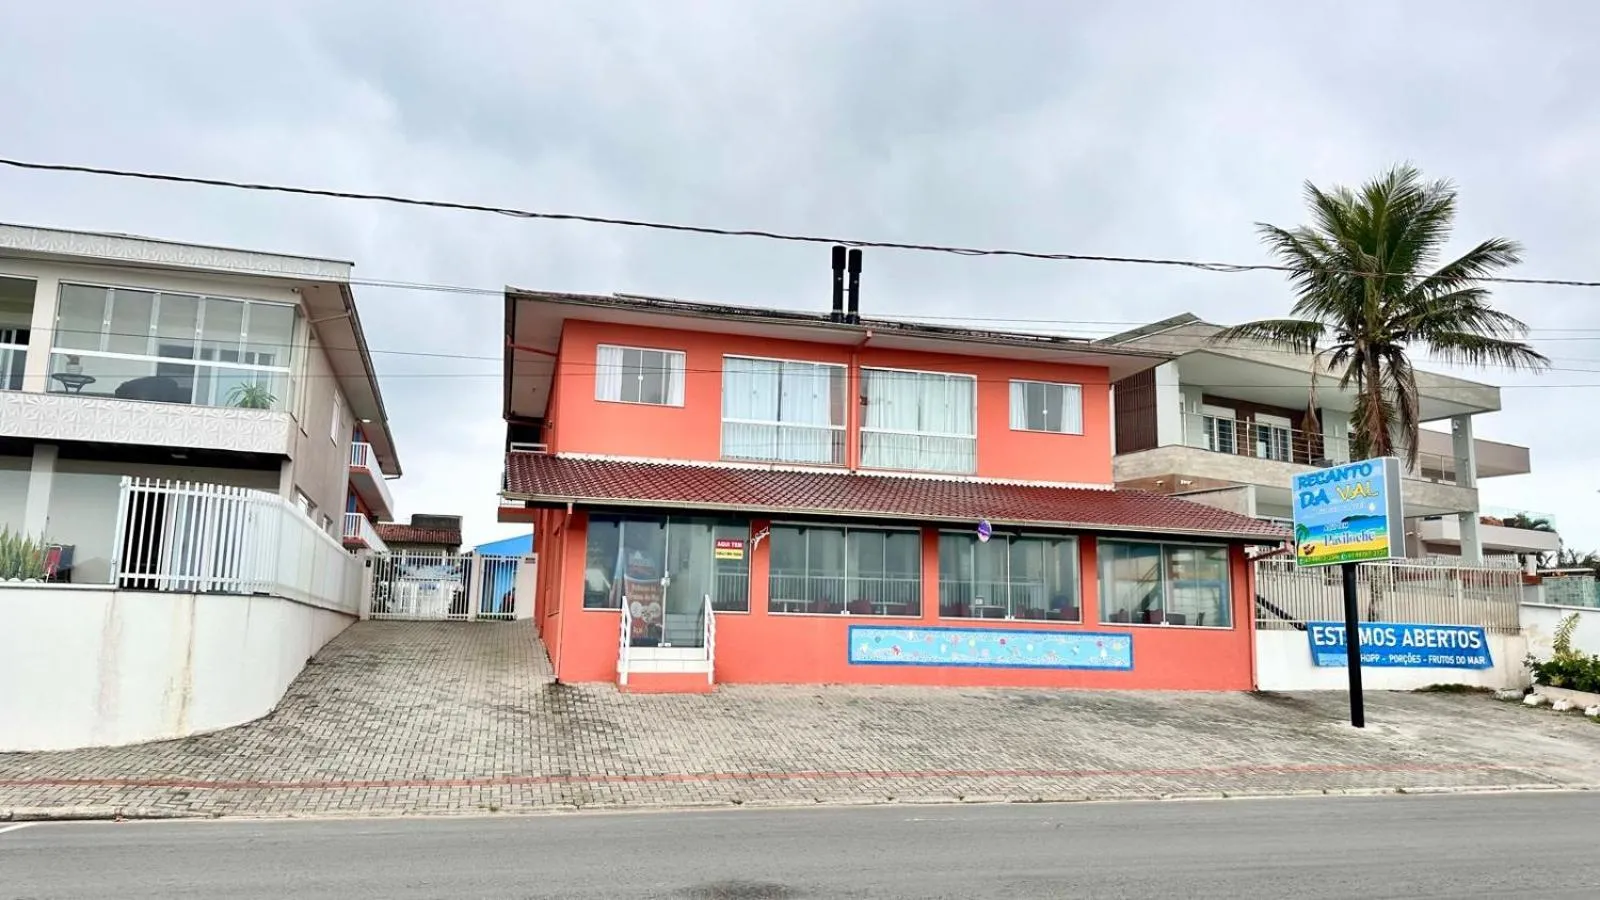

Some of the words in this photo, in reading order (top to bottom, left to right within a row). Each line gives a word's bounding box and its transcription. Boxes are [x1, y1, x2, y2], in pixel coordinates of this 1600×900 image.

[1297, 462, 1373, 489] RECANTO
[1299, 488, 1330, 509] DA
[1336, 481, 1379, 501] VAL
[1312, 626, 1397, 647] ESTMOS
[1402, 628, 1481, 649] ABERTOS
[1360, 653, 1380, 663] HOPP
[1388, 652, 1421, 665] PORÇÕES
[1428, 655, 1455, 665] FRUTOS
[1456, 656, 1466, 665] DO
[1467, 656, 1485, 665] MAR
